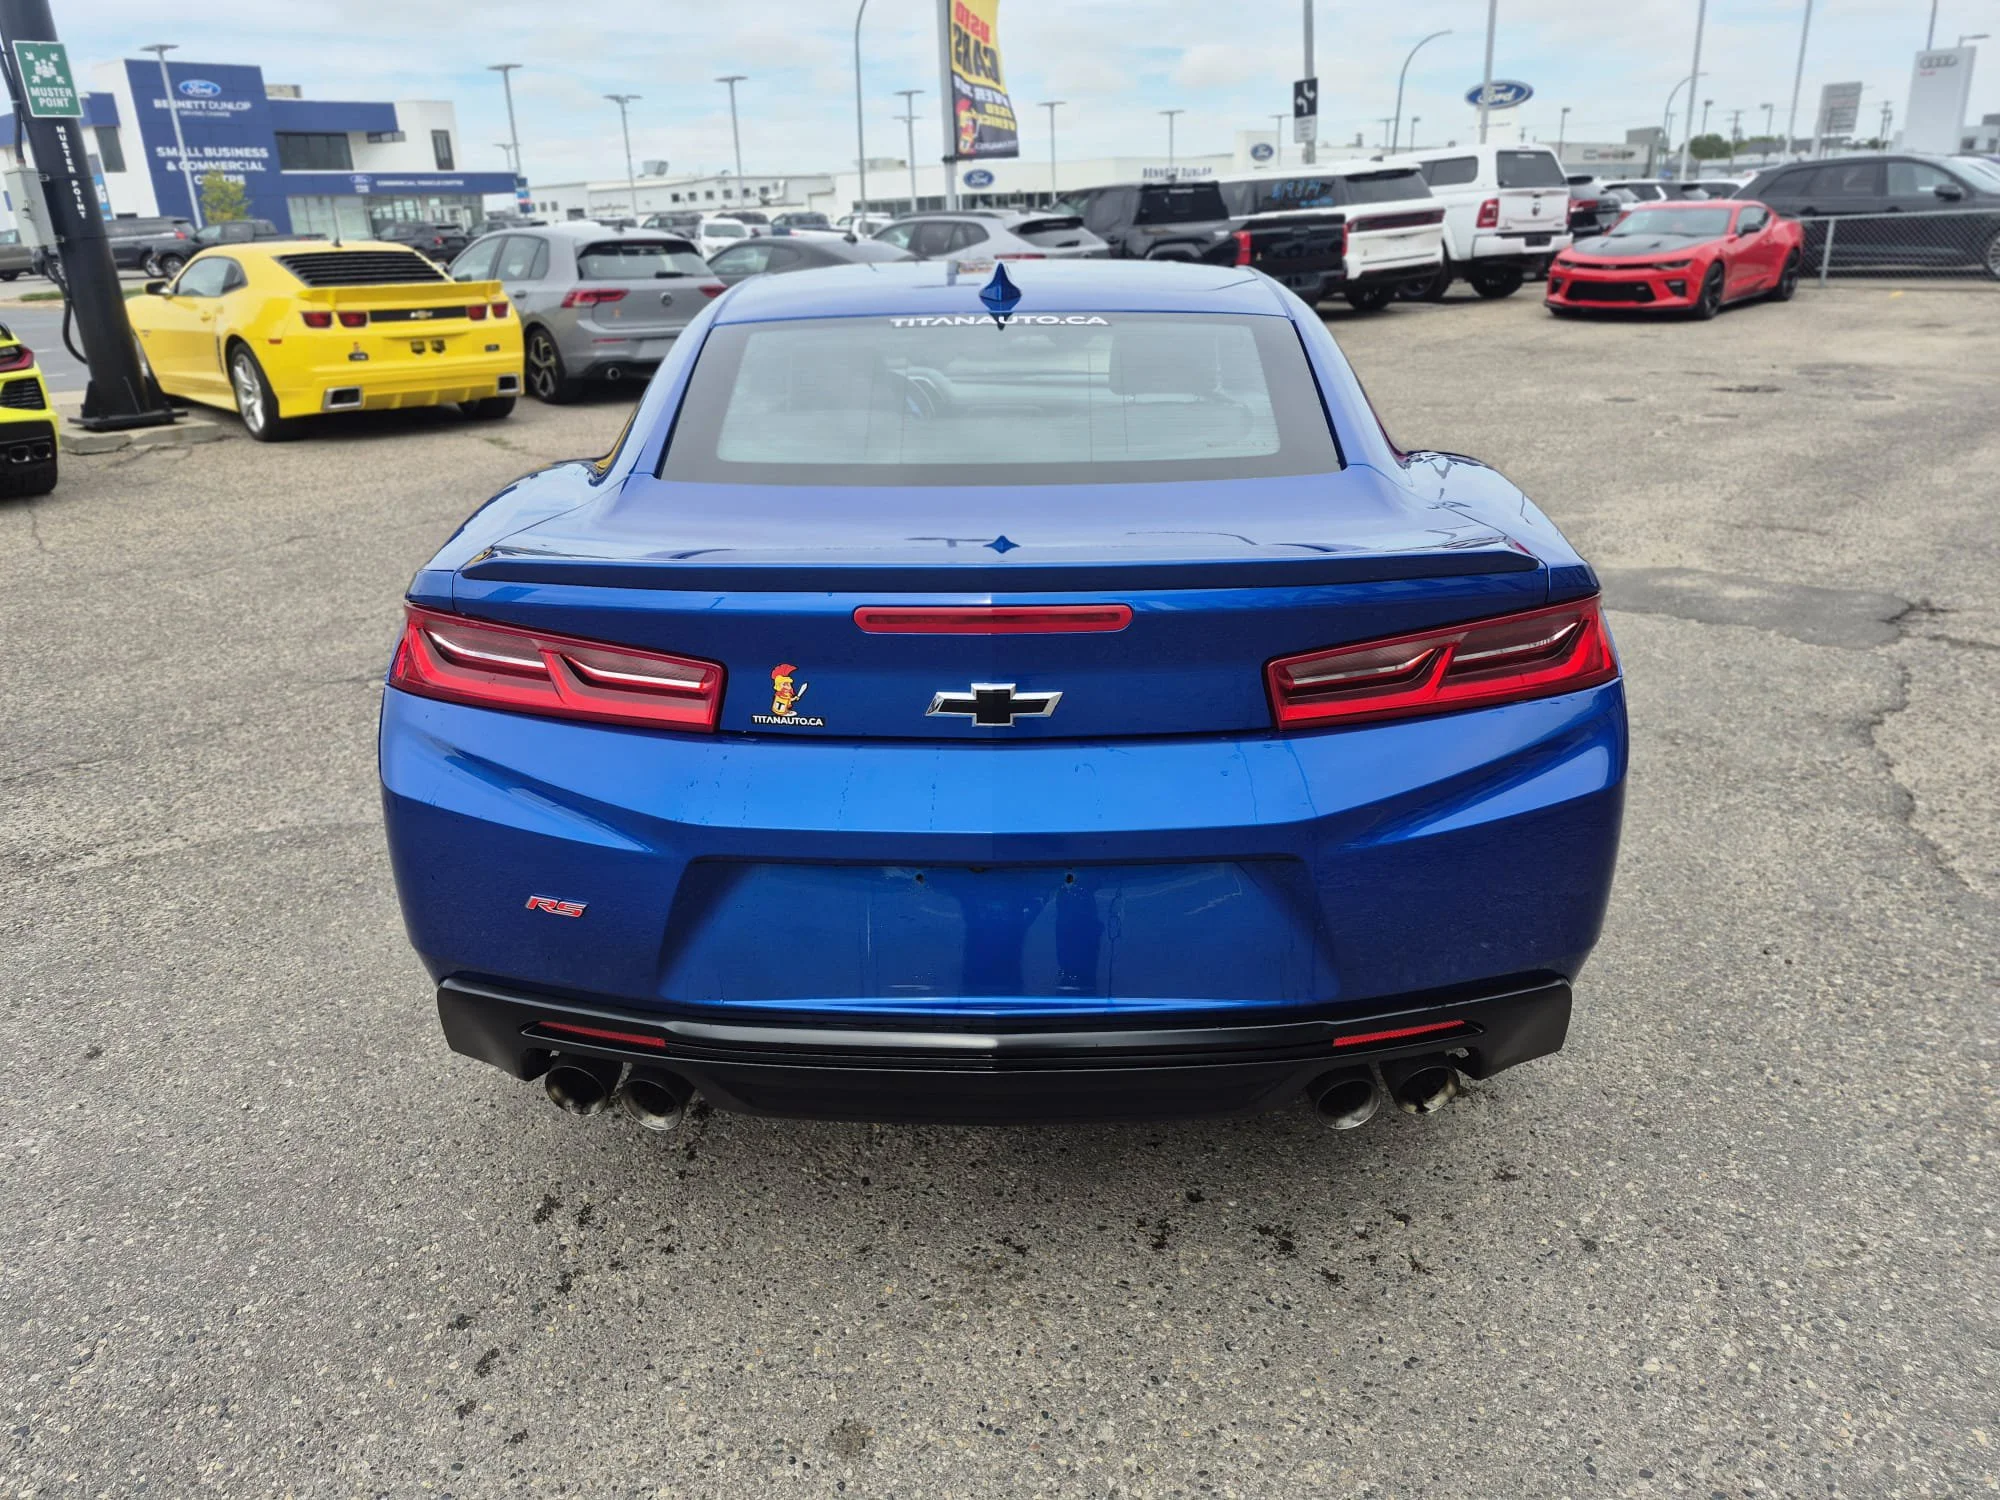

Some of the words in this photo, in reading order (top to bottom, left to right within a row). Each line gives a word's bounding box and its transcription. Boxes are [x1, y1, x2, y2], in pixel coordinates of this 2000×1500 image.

[30, 87, 73, 97] MUSTER
[38, 98, 69, 108] POINT
[208, 101, 252, 111] DUNLOP
[56, 126, 76, 173] MUSTER
[204, 147, 269, 158] BUSINESS
[166, 161, 177, 171] &
[194, 174, 246, 185] CTRE
[71, 180, 86, 219] POINT
[889, 315, 1109, 328] TITANAUTO.CA
[752, 715, 824, 727] TITANAUTO.CA
[525, 895, 588, 918] RS
